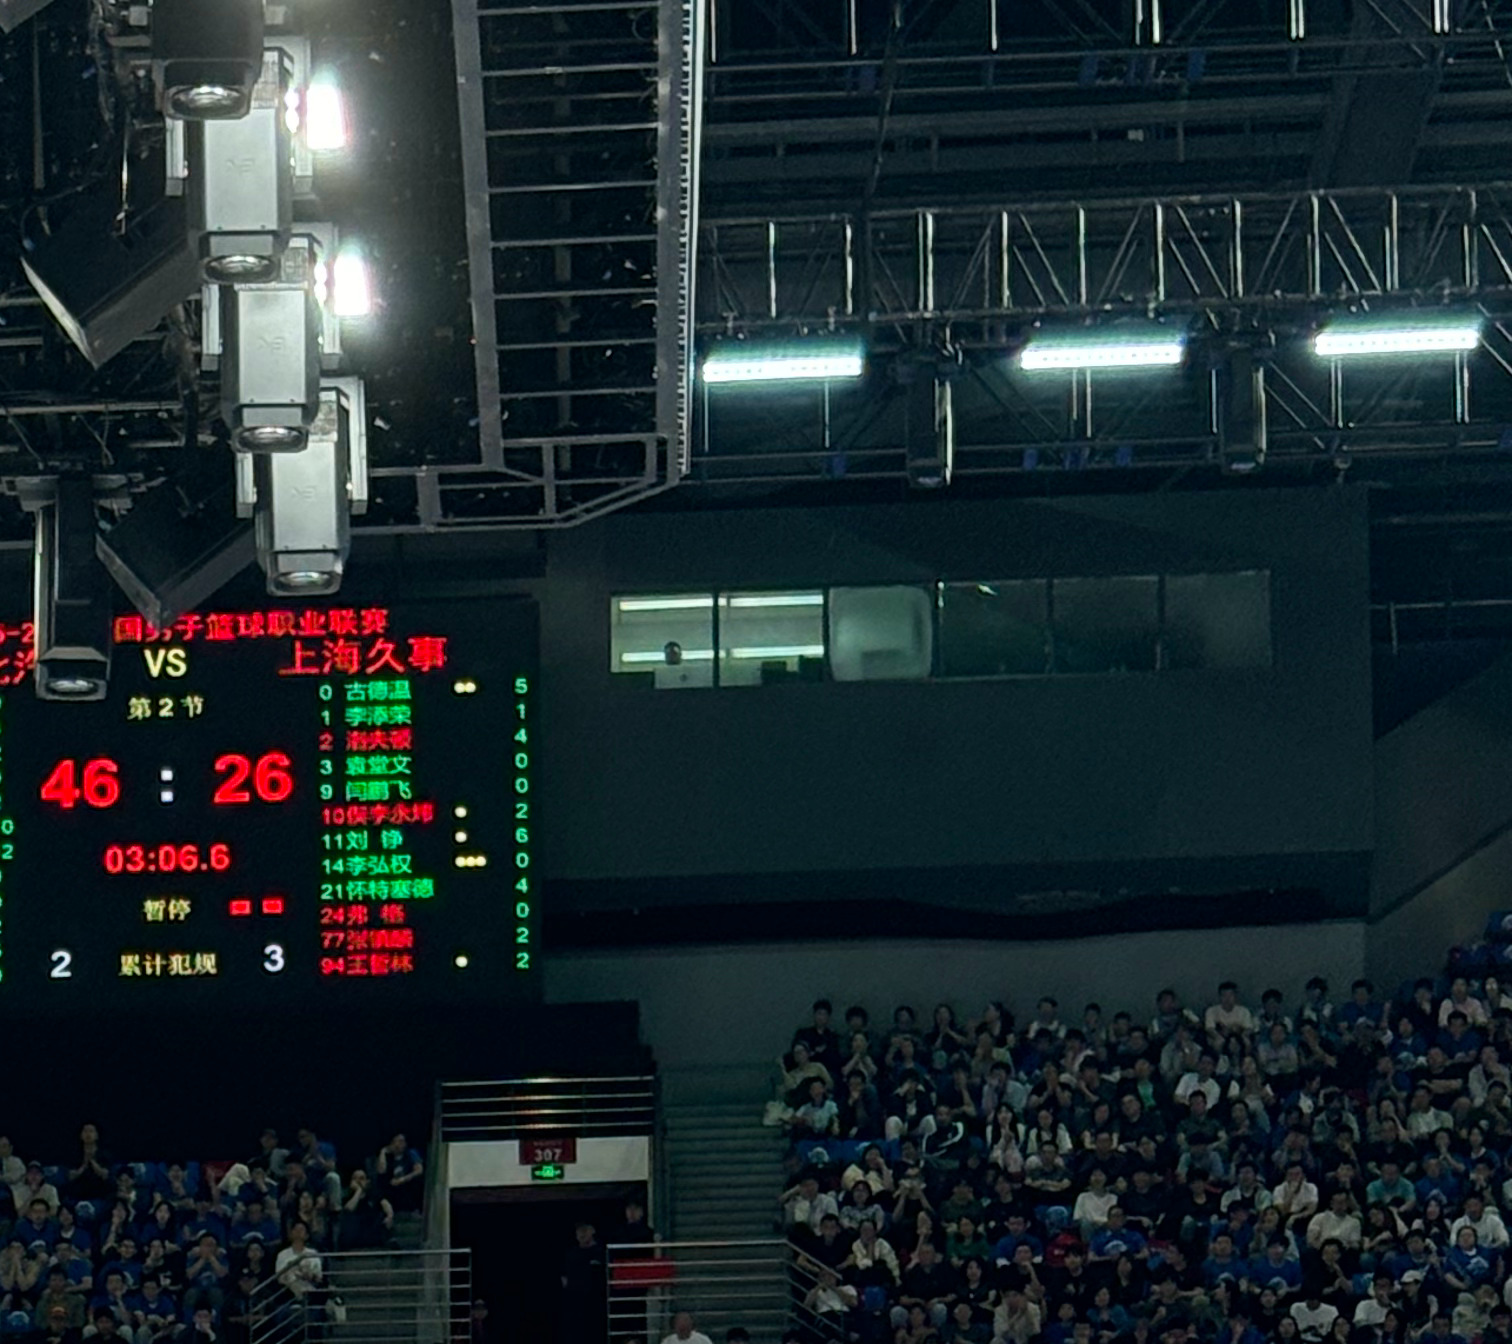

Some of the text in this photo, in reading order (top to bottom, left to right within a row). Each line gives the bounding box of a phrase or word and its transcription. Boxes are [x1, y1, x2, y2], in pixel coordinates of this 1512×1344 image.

[144, 649, 186, 677] VS
[278, 637, 447, 675] 上海久事
[319, 685, 332, 700] 0
[515, 678, 527, 693] 5
[322, 710, 330, 725] 1
[518, 704, 525, 719] 1
[319, 735, 332, 750] 2
[514, 728, 527, 743] 4
[320, 760, 332, 775] 3
[515, 753, 527, 769] 0
[40, 758, 120, 808] 46
[213, 752, 293, 803] 26
[320, 785, 332, 800] 9
[515, 778, 528, 793] 0
[322, 809, 344, 824] 10
[515, 804, 528, 819] 2
[322, 834, 343, 849] 11
[516, 828, 528, 843] 6
[104, 845, 231, 873] 03:06.6
[322, 853, 528, 876] 14 李弘权 0
[321, 884, 343, 900] 21
[515, 878, 528, 893] 4
[143, 899, 191, 921] 暂停
[321, 908, 344, 924] 24
[516, 903, 528, 918] 0
[321, 933, 344, 948] 77
[516, 928, 529, 944] 2
[50, 944, 286, 978] 2 累计犯规 3
[321, 958, 344, 974] 94
[516, 953, 529, 969] 2
